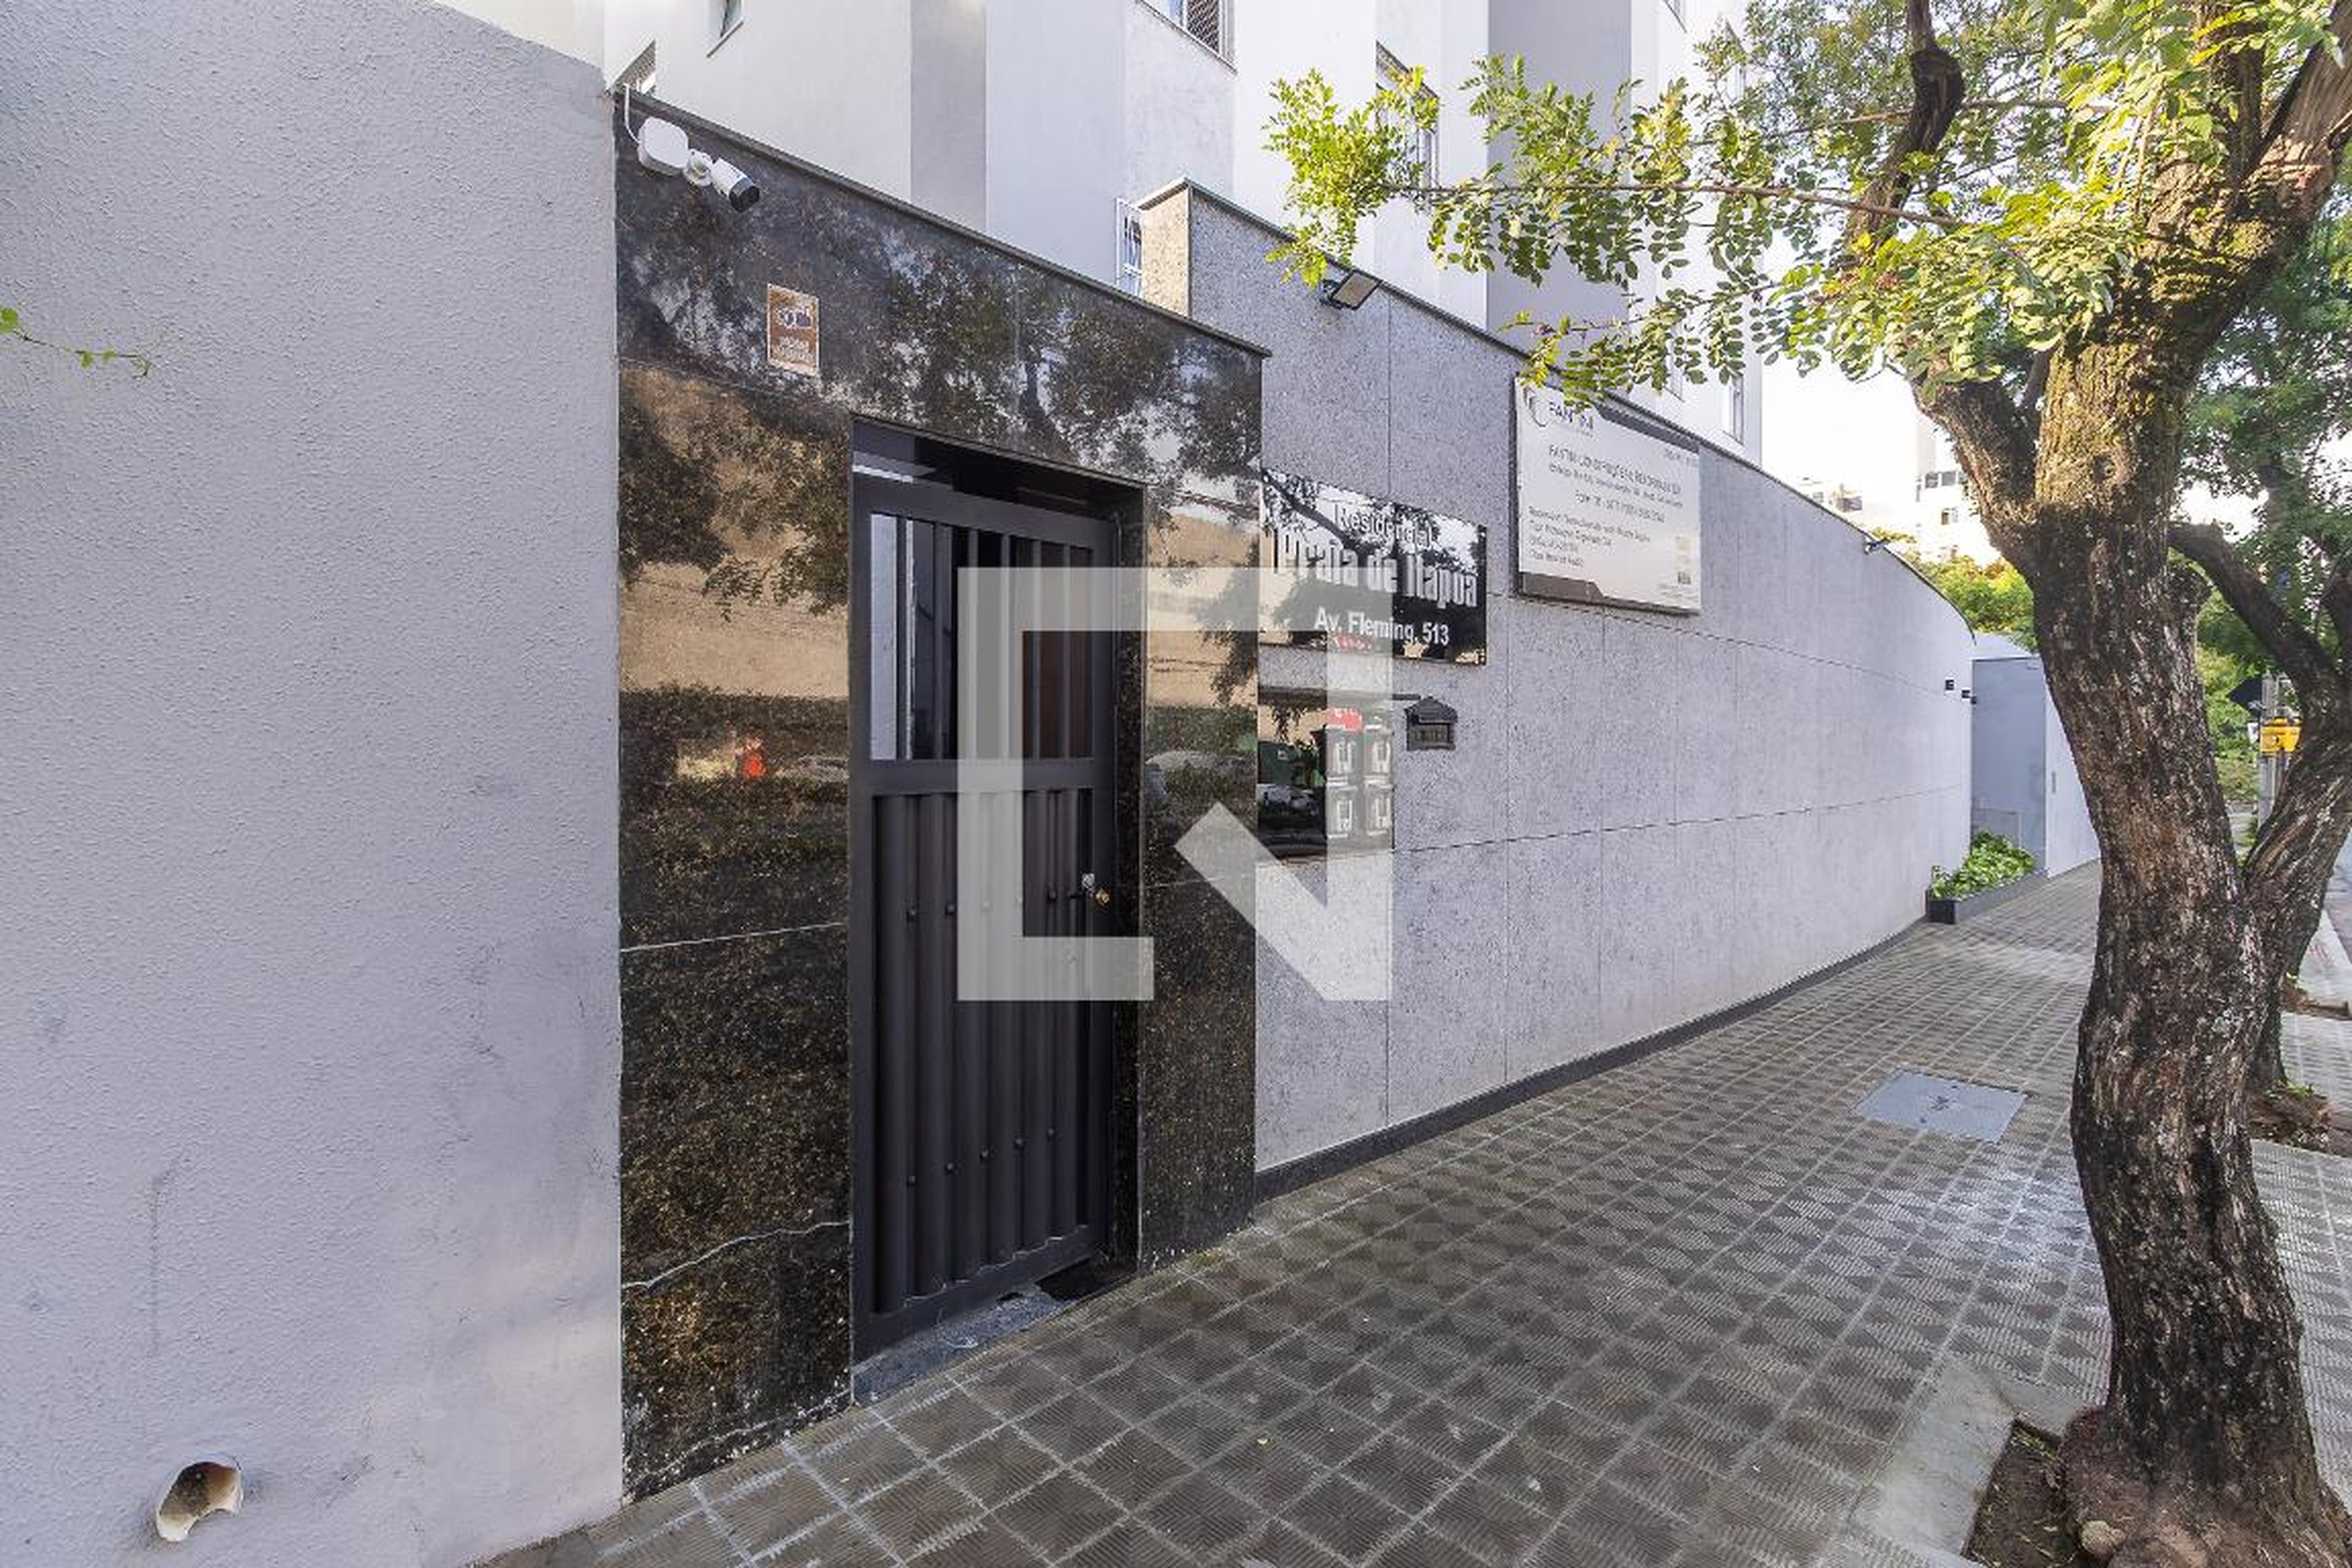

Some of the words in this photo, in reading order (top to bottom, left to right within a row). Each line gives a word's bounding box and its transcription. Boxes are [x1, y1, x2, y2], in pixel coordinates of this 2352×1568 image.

[1278, 526, 1358, 587] Praia
[1367, 549, 1397, 593] de
[1314, 606, 1342, 632] Av.
[1422, 621, 1449, 646] 513
